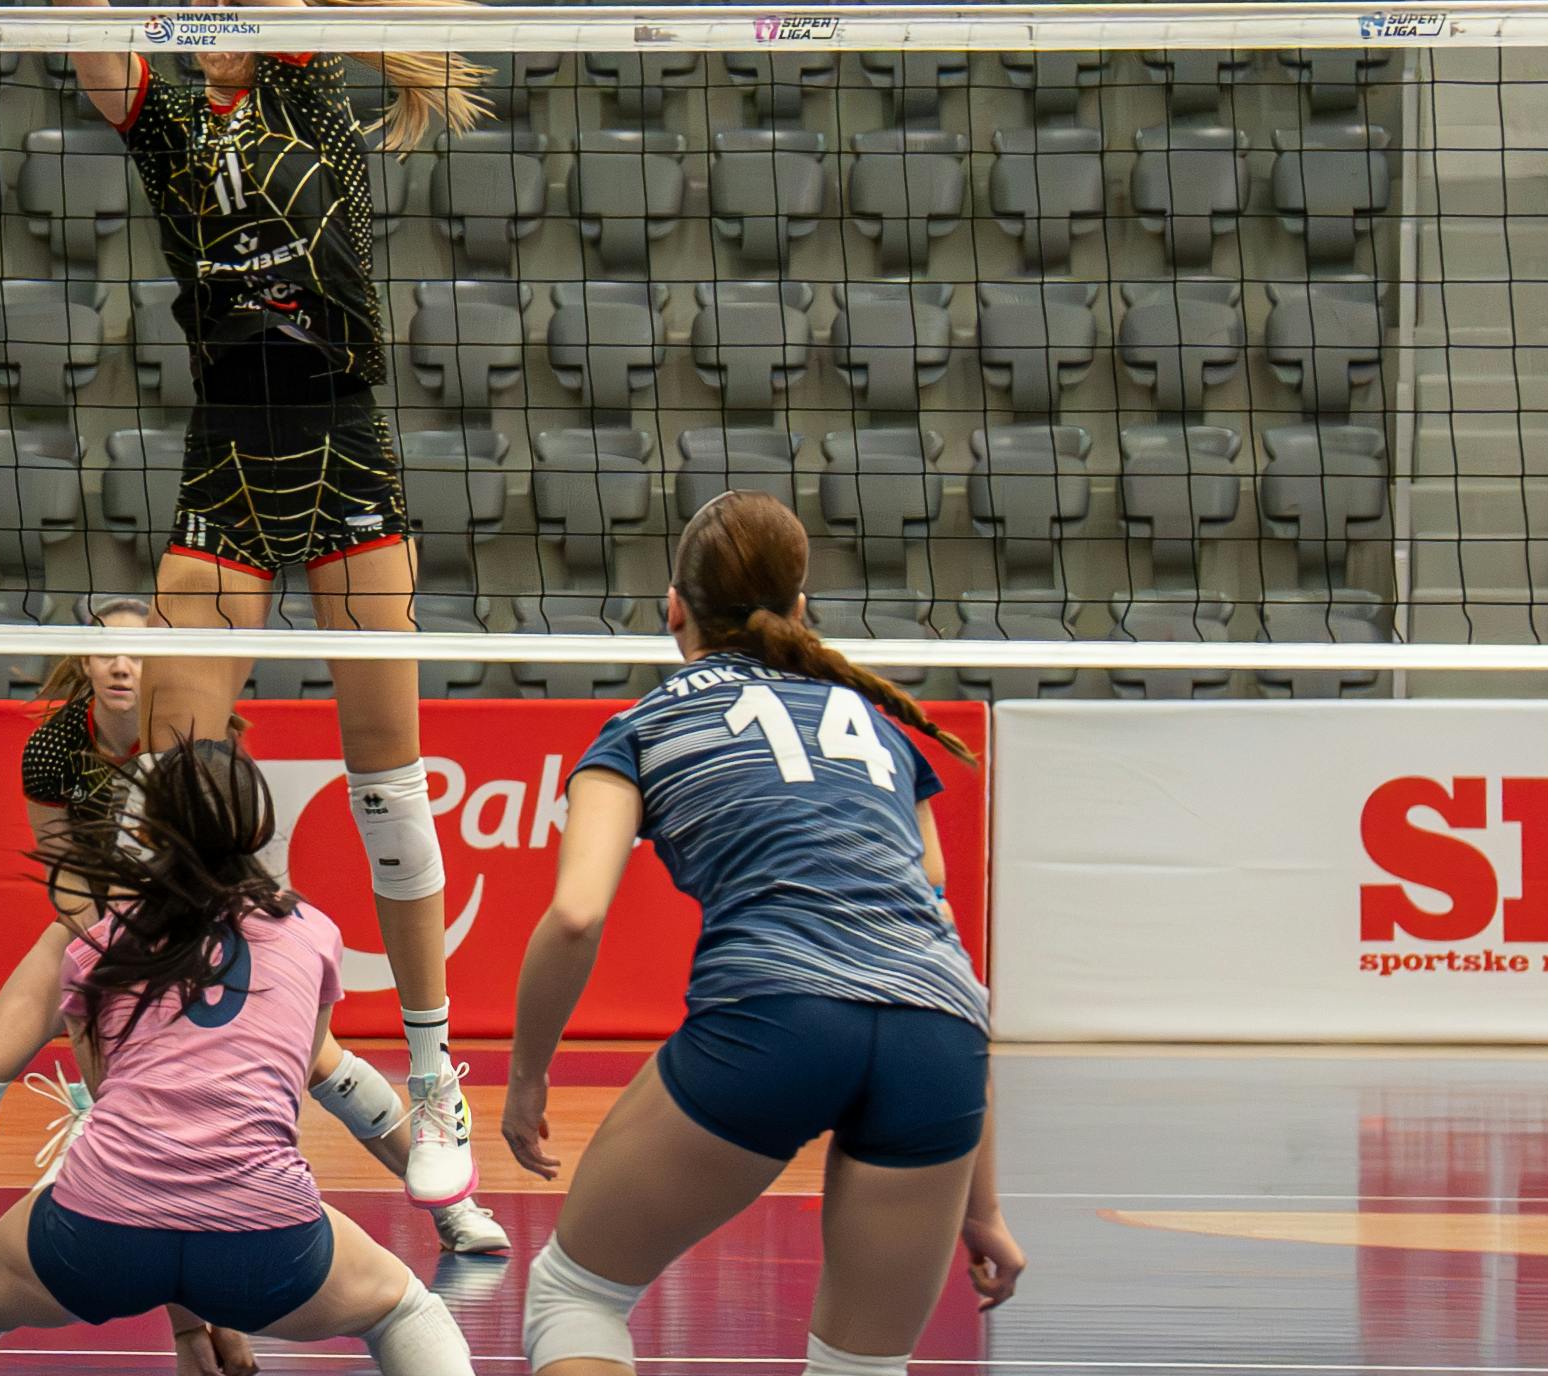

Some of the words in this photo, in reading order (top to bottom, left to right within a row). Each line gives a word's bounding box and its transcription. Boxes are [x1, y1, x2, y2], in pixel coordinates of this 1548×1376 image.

[176, 12, 239, 22] HRVATSKI
[782, 17, 831, 28] SUPER
[1387, 13, 1437, 25] SUPER
[778, 29, 811, 40] LIGA
[1384, 25, 1417, 37] LIGA
[176, 35, 217, 46] SAVEZ
[723, 684, 897, 792] 14
[1359, 949, 1530, 977] sportske
